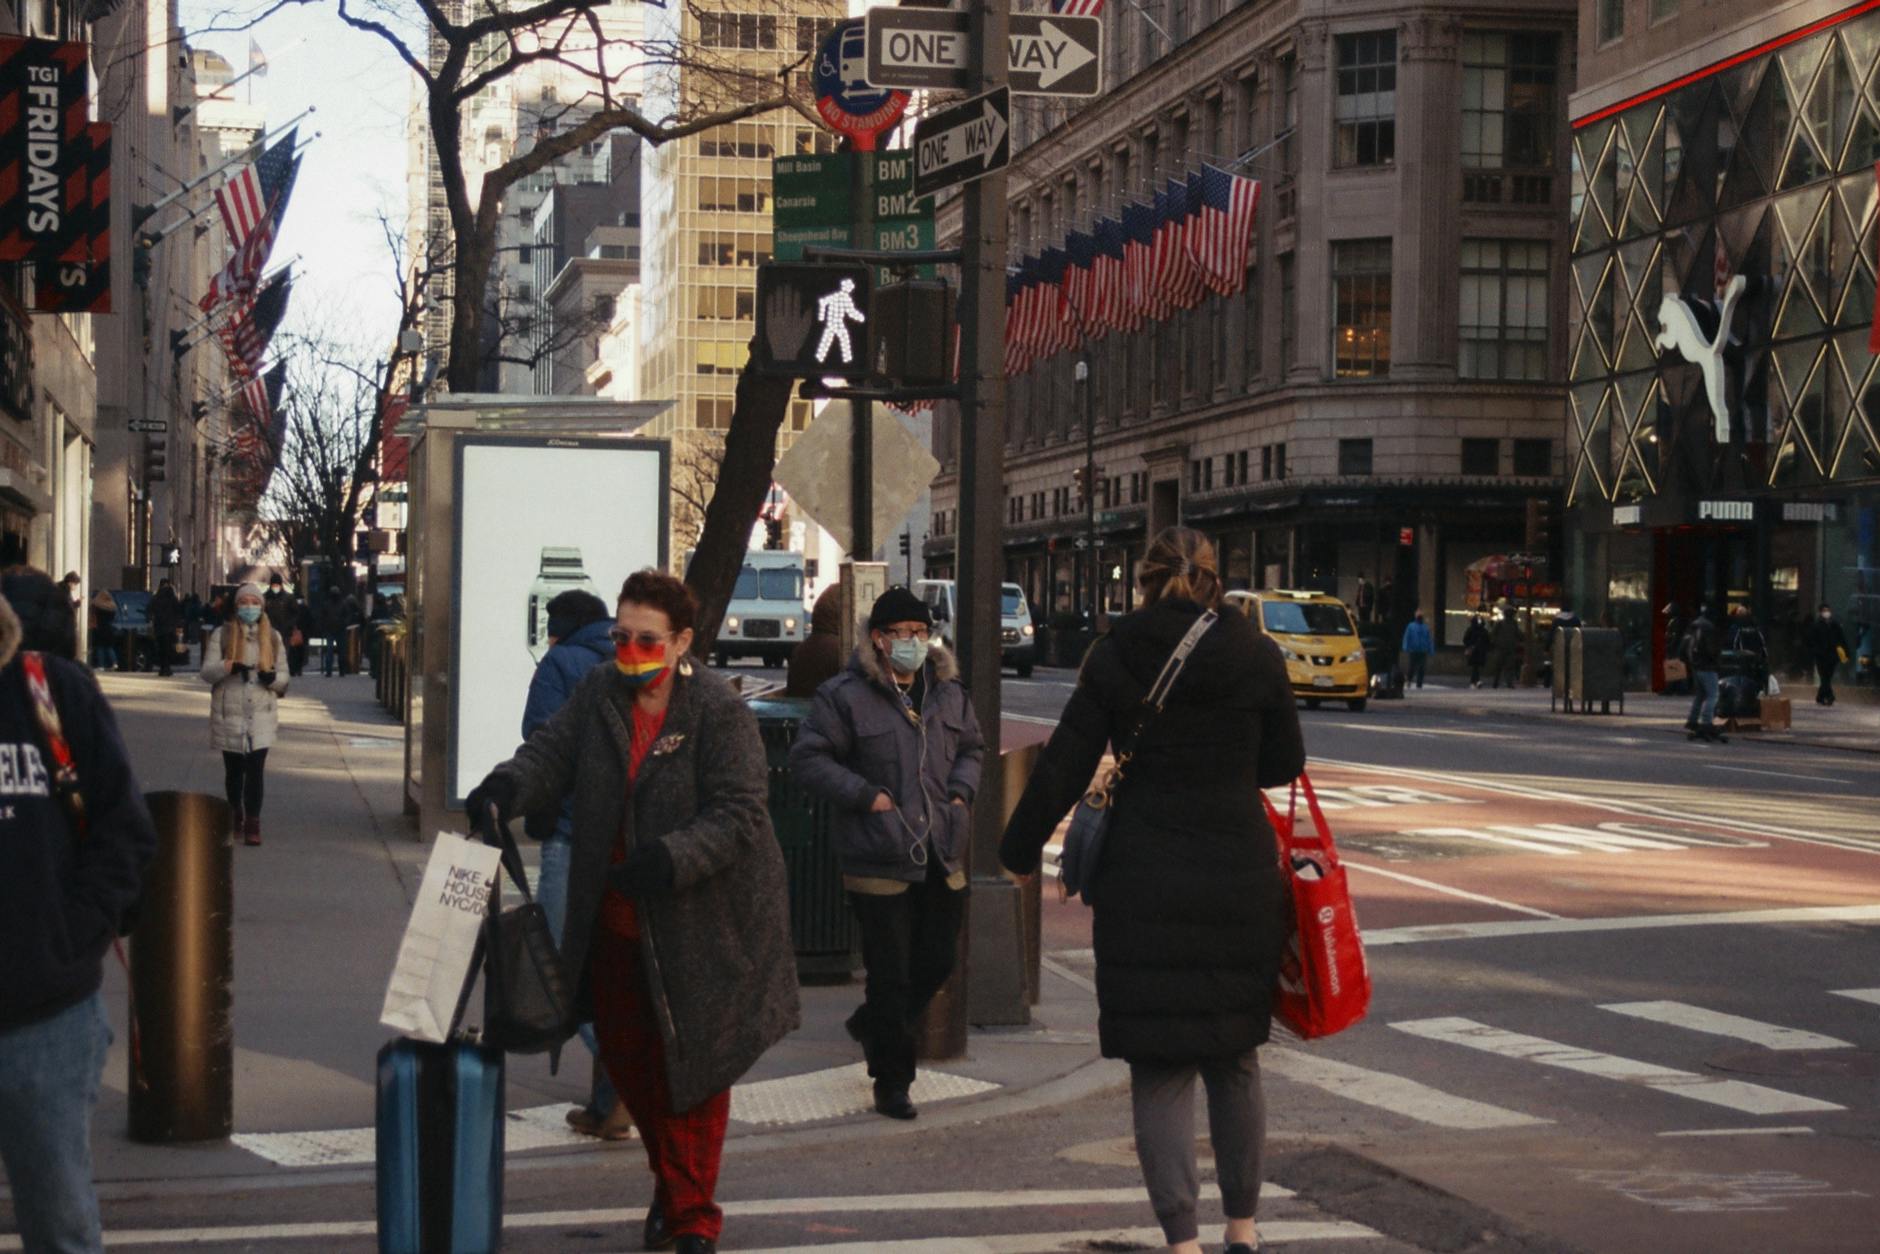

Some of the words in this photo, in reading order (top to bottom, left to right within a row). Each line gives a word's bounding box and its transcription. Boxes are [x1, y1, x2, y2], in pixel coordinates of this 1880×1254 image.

[889, 33, 956, 64] ONE
[28, 66, 59, 82] TGI
[824, 102, 841, 121] NO
[841, 95, 901, 130] STANDING
[921, 134, 949, 171] ONE
[964, 116, 997, 155] WAY
[28, 85, 59, 233] FRIDAYS
[776, 161, 793, 174] Mill
[795, 160, 822, 173] Basin
[878, 158, 913, 181] BM
[776, 195, 817, 209] Canarsie
[878, 191, 921, 216] BM2
[880, 224, 919, 250] BM3
[1699, 501, 1753, 520] PUMA
[448, 865, 481, 885] NIKE
[1323, 925, 1340, 996] lululemon
